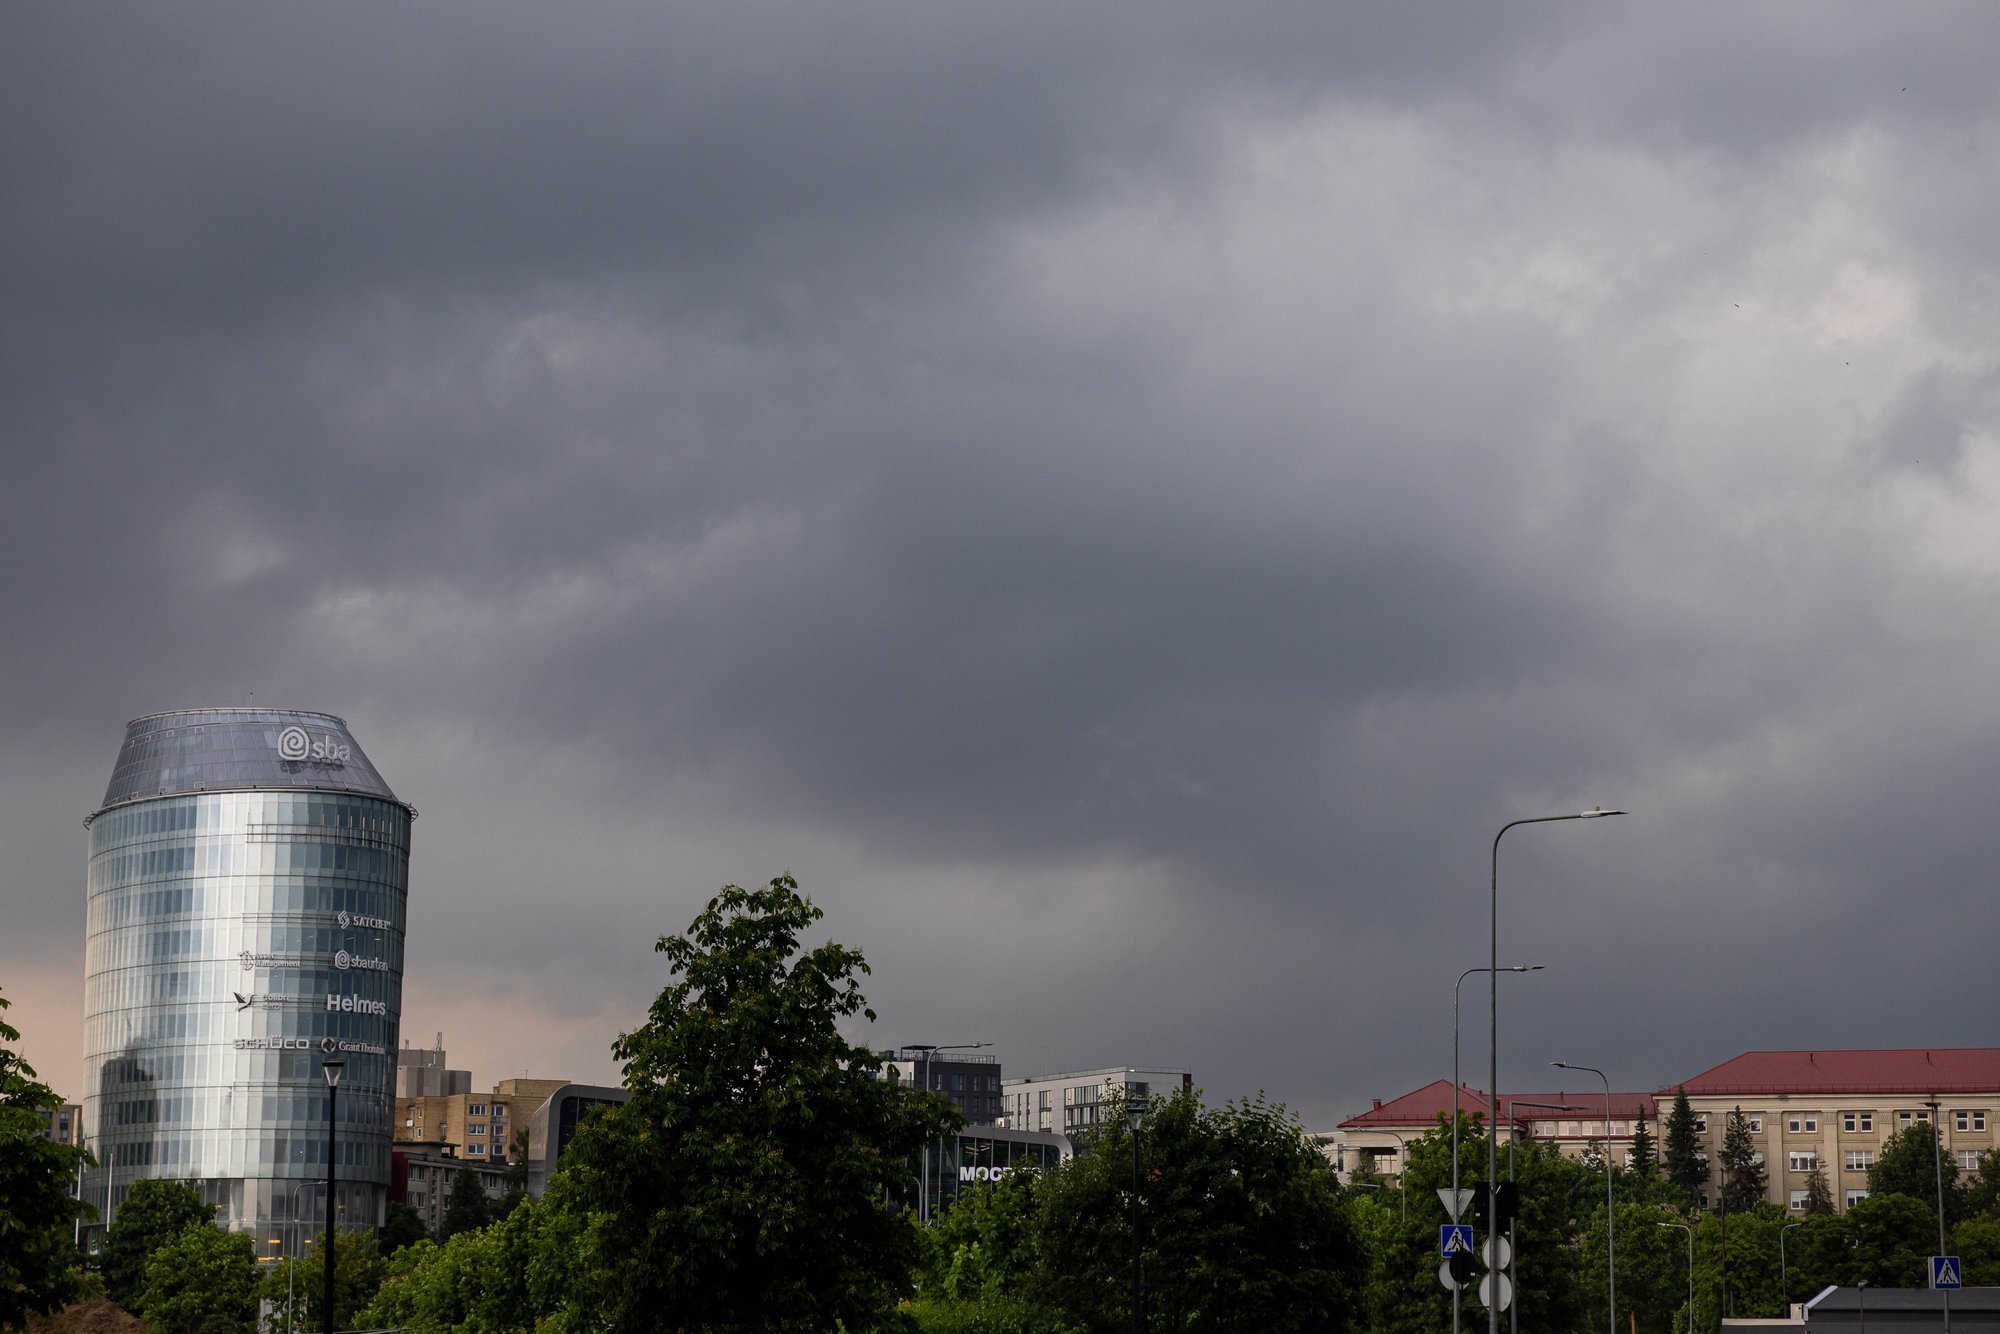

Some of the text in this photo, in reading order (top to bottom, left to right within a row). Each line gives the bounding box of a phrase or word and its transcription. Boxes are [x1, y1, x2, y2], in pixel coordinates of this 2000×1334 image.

[312, 735, 351, 761] sba
[255, 959, 301, 969] Management
[327, 993, 386, 1015] Helmes
